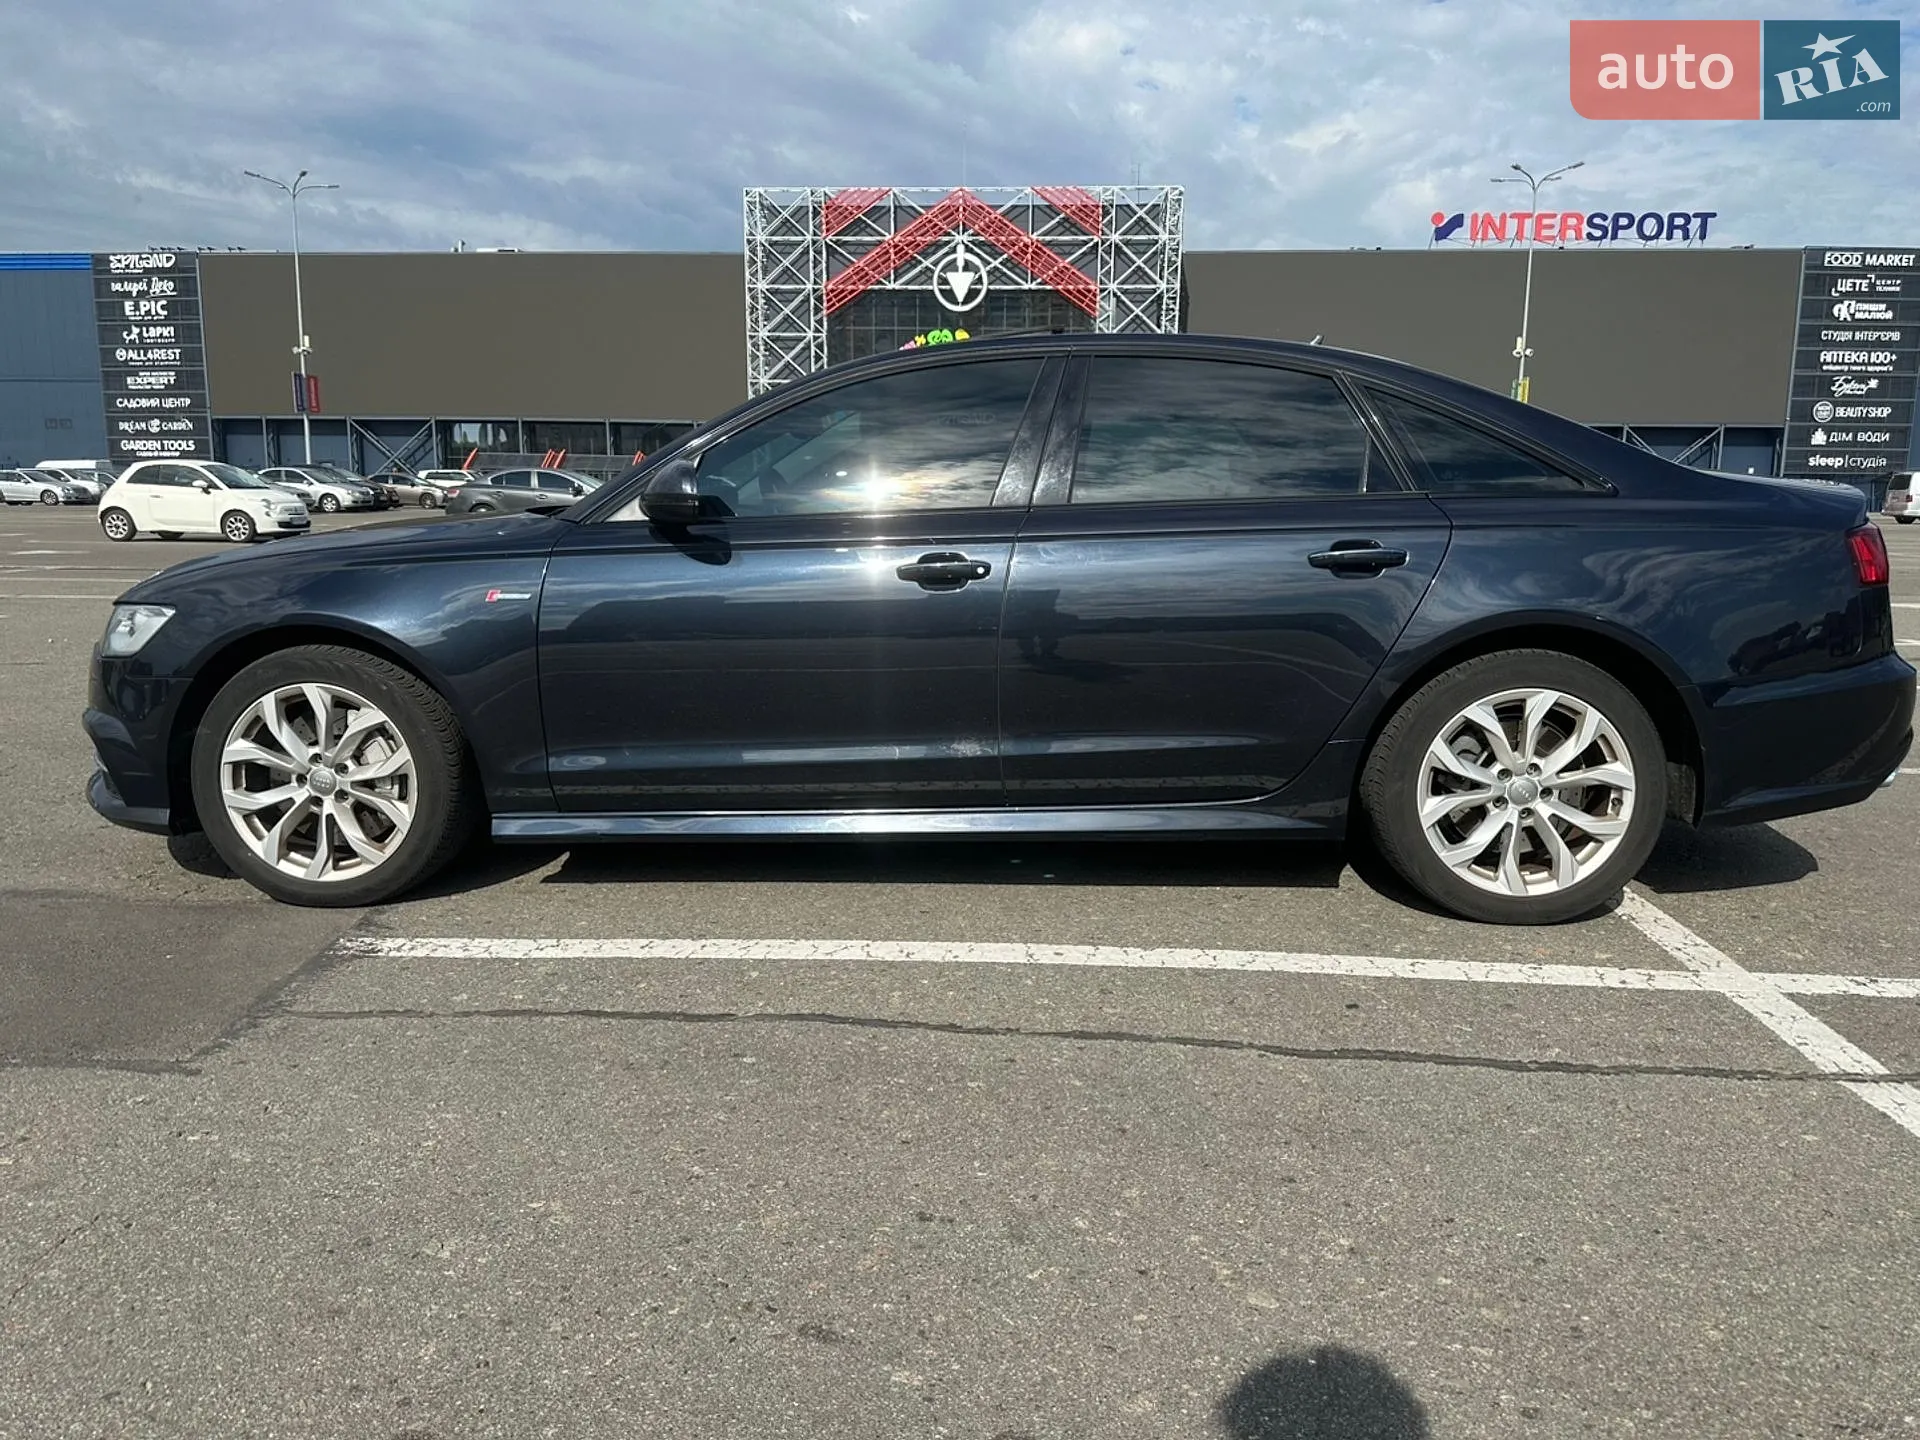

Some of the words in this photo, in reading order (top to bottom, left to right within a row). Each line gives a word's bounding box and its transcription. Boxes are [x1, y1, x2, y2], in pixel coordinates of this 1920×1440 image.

[1469, 211, 1717, 242] INTERSPORT
[1824, 252, 1863, 267] FOOD
[1865, 254, 1915, 267] MARKET
[124, 300, 168, 316] E.PIC
[1820, 351, 1868, 363] АПТЕКА
[1870, 351, 1897, 364] 100+
[127, 376, 176, 385] EXPERT
[162, 397, 191, 409] ЦЕНТР
[1835, 406, 1867, 418] BEAUTY
[1868, 406, 1892, 418] SHOP
[1829, 431, 1853, 442] ДІМ
[1857, 431, 1890, 443] ВОДИ
[120, 440, 161, 451] GARDEN
[163, 440, 195, 451] TOOLS
